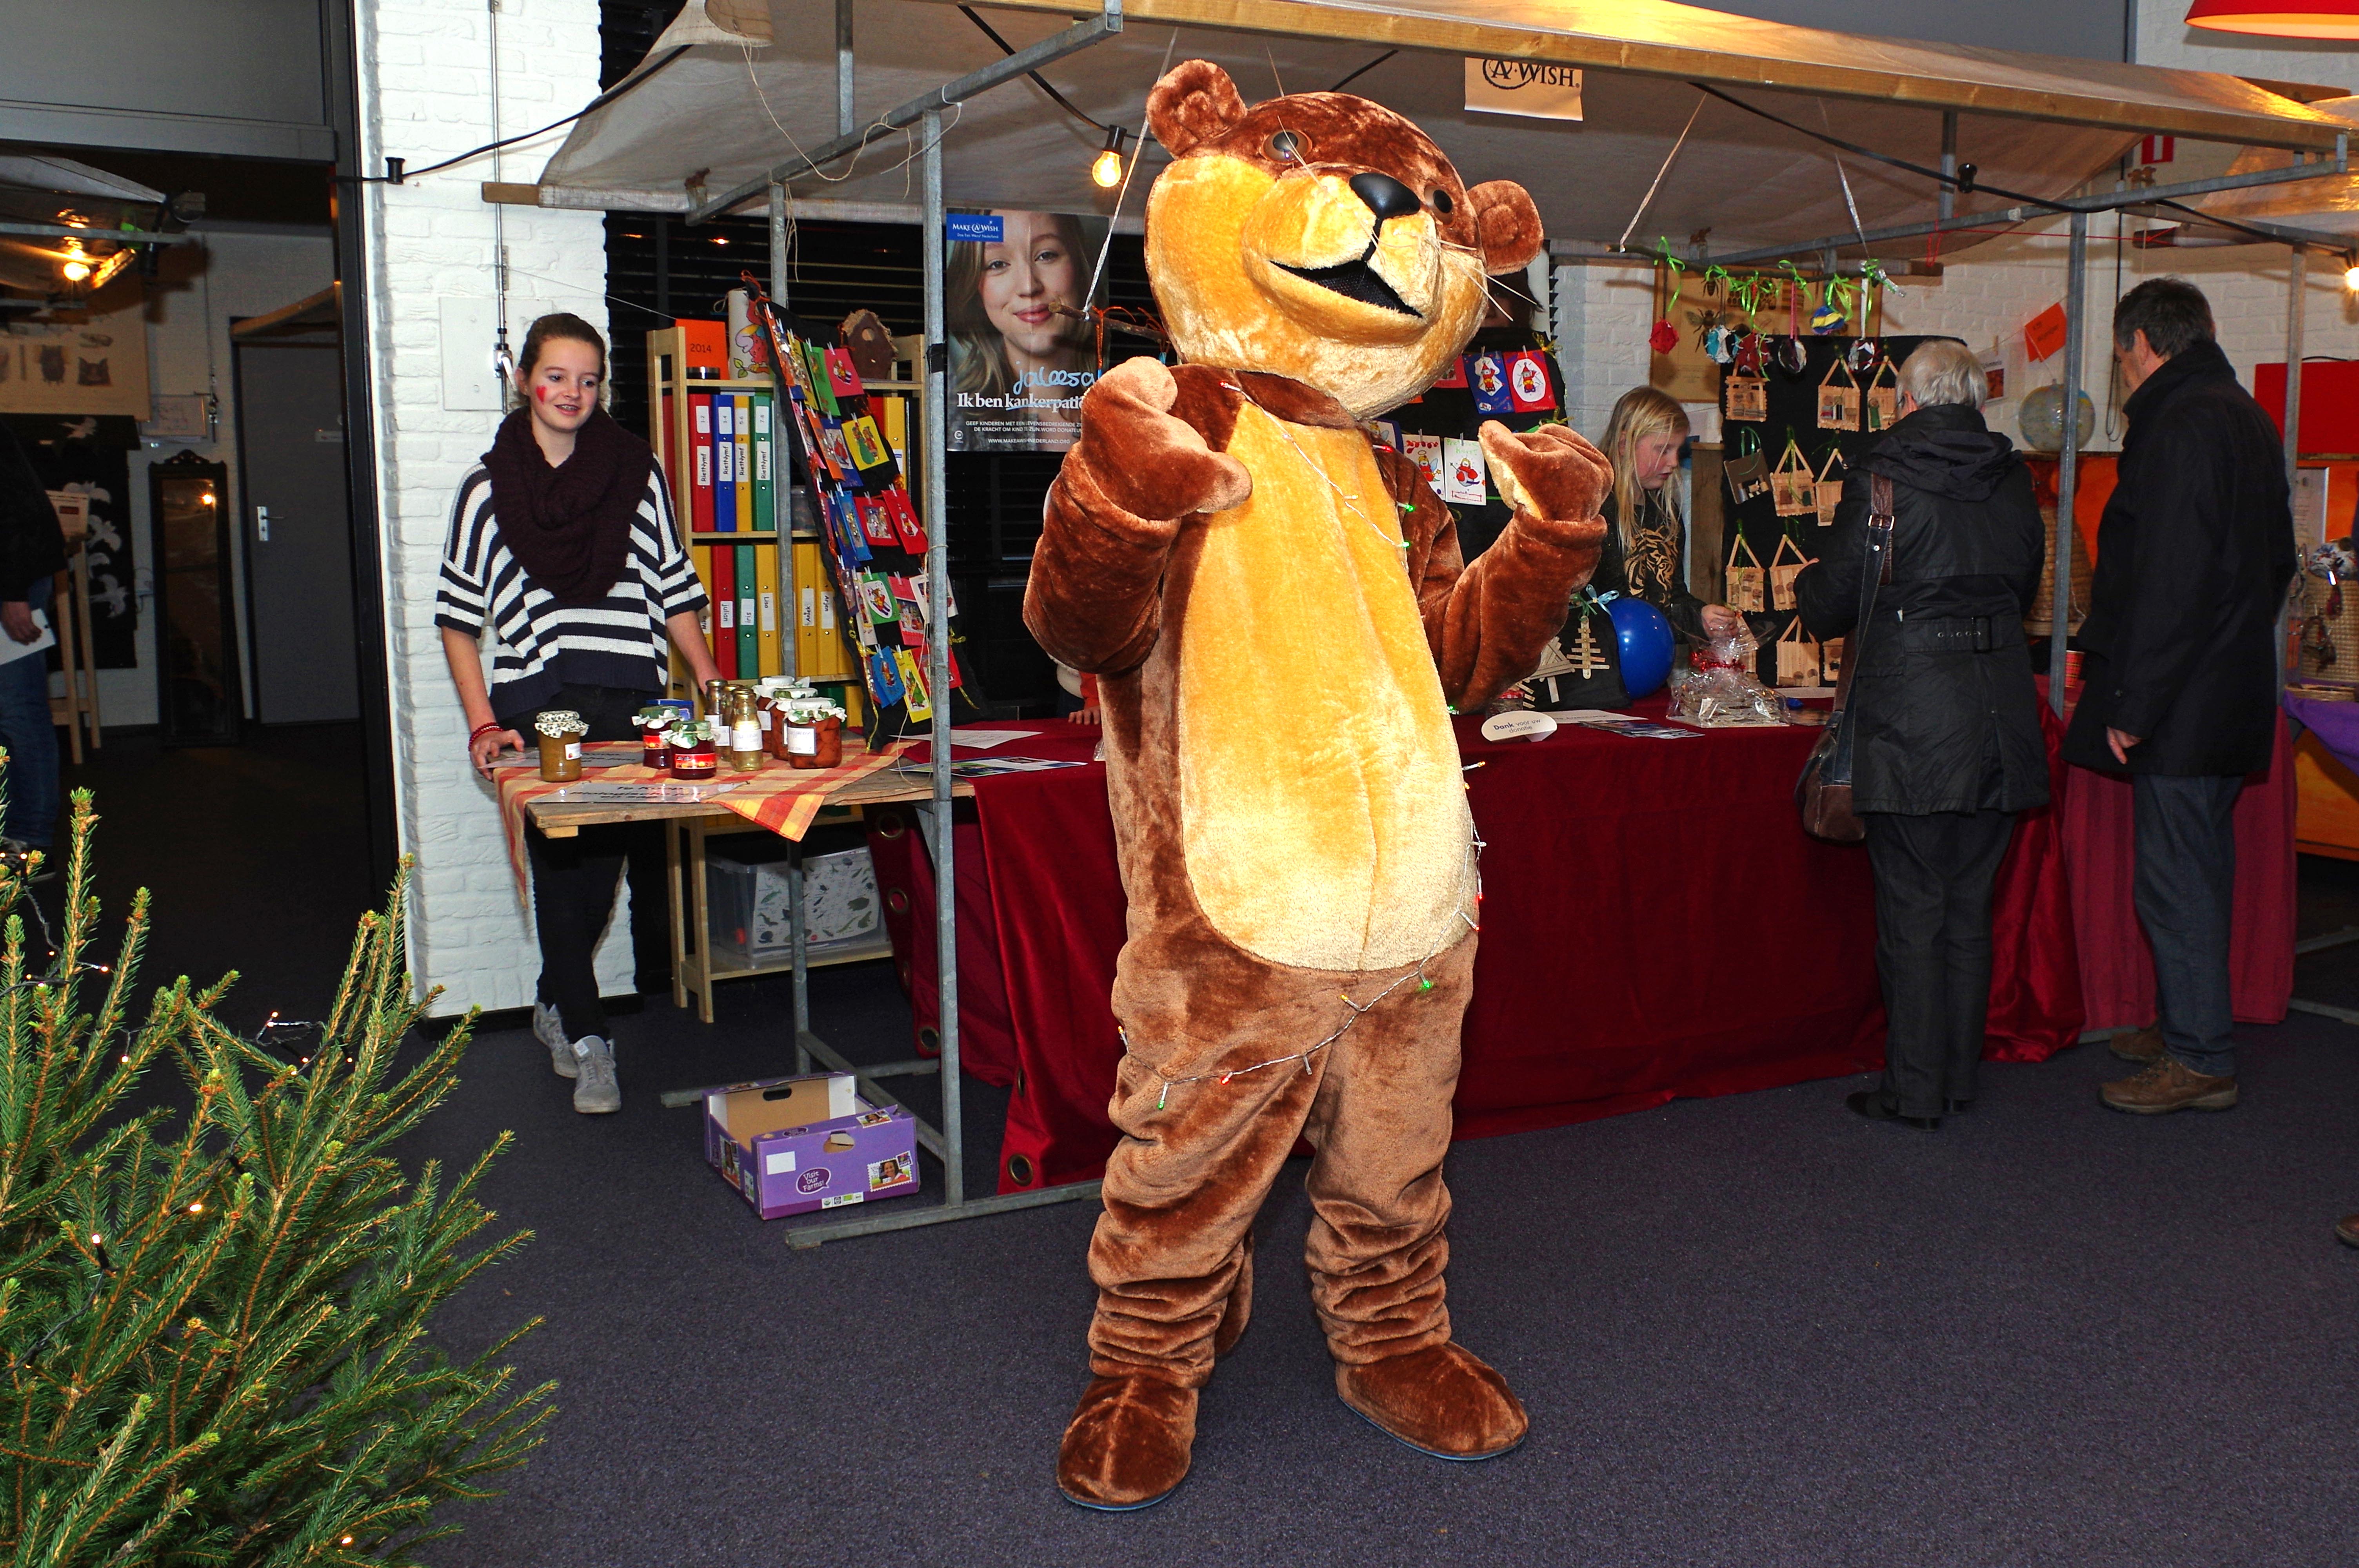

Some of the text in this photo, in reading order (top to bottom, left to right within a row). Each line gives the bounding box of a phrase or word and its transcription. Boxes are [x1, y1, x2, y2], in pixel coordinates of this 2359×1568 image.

[690, 343, 711, 353] 2014
[957, 393, 974, 407] Ik
[974, 393, 1003, 408] ben
[803, 1171, 819, 1180] Visit
[803, 1180, 824, 1192] Farms!
